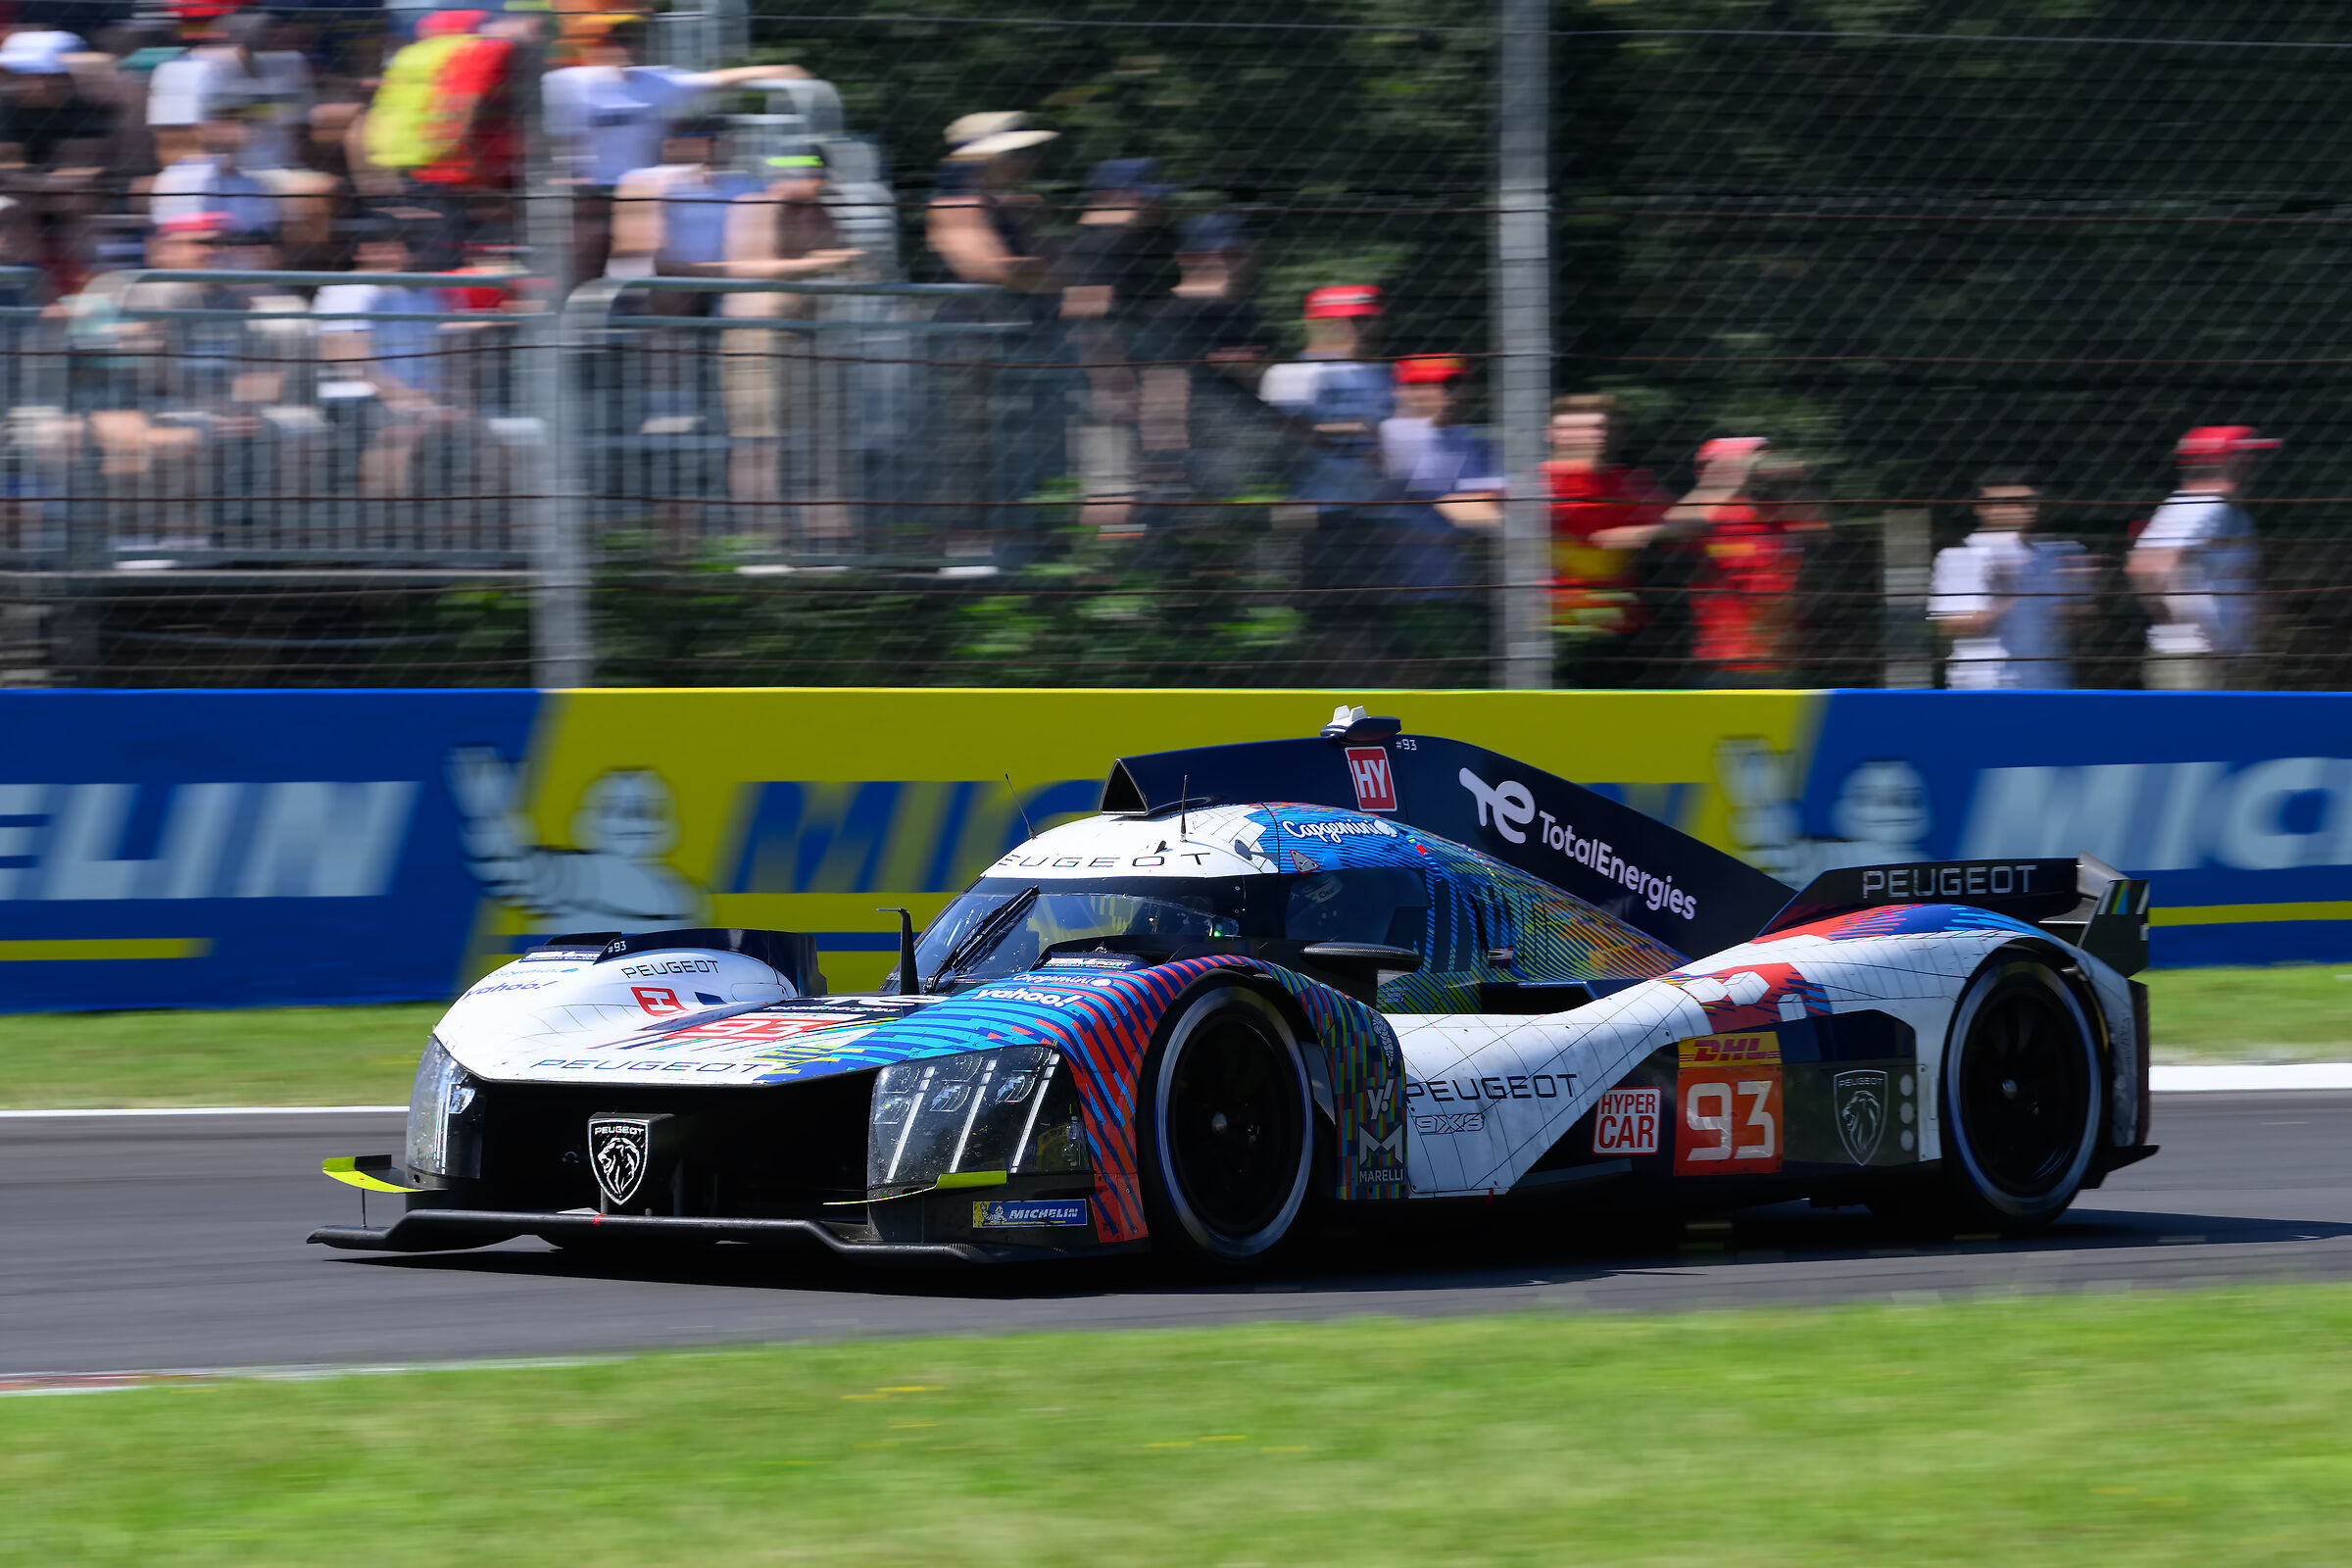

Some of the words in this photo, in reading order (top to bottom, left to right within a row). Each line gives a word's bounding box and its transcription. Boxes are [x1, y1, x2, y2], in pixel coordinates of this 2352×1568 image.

[1396, 738, 1417, 752] #93
[1351, 759, 1388, 799] HY
[1282, 818, 1382, 844] Capgemini
[997, 852, 1211, 867] EUGEOT
[1539, 809, 1697, 920] TotalEnergies
[1862, 864, 2037, 900] PEUGEOT
[608, 940, 627, 954] #93
[620, 959, 719, 979] PEUGEOT
[972, 988, 1084, 1007] yahoo!
[1692, 1038, 1768, 1062] DHL
[529, 1058, 772, 1074] PEUGEOT
[1405, 1073, 1578, 1104] PEUGEOT
[1600, 1093, 1656, 1114] HYPER
[594, 1125, 645, 1136] PEUGEOT
[1686, 1080, 1776, 1161] 93
[1598, 1115, 1654, 1150] CAR
[1358, 1168, 1403, 1184] MARELLI
[1008, 1207, 1079, 1219] MICHELIN
